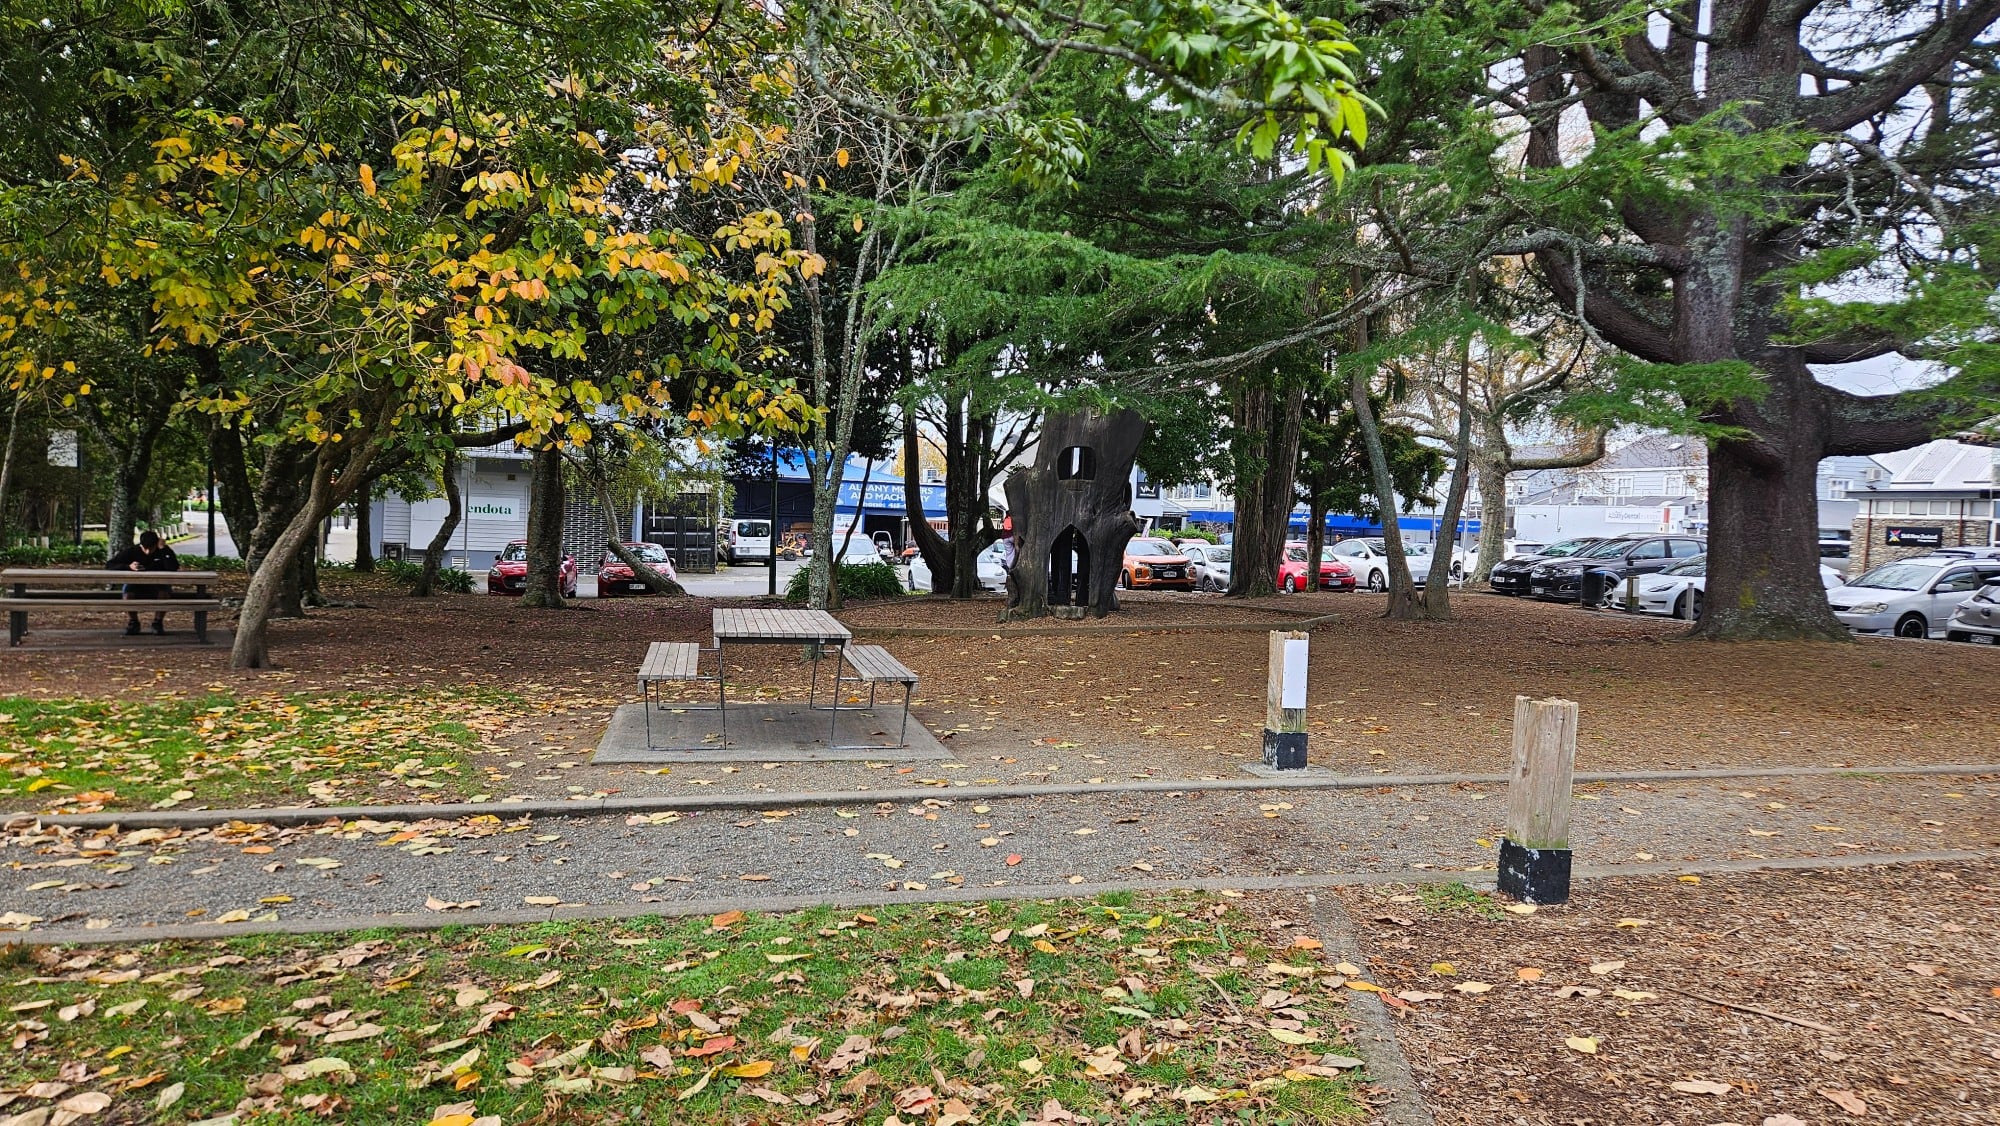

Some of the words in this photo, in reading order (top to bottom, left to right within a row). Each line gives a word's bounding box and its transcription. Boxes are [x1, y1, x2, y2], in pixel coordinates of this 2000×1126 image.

[848, 483, 890, 493] ALANY
[851, 492, 873, 500] AD
[467, 503, 512, 515] endota
